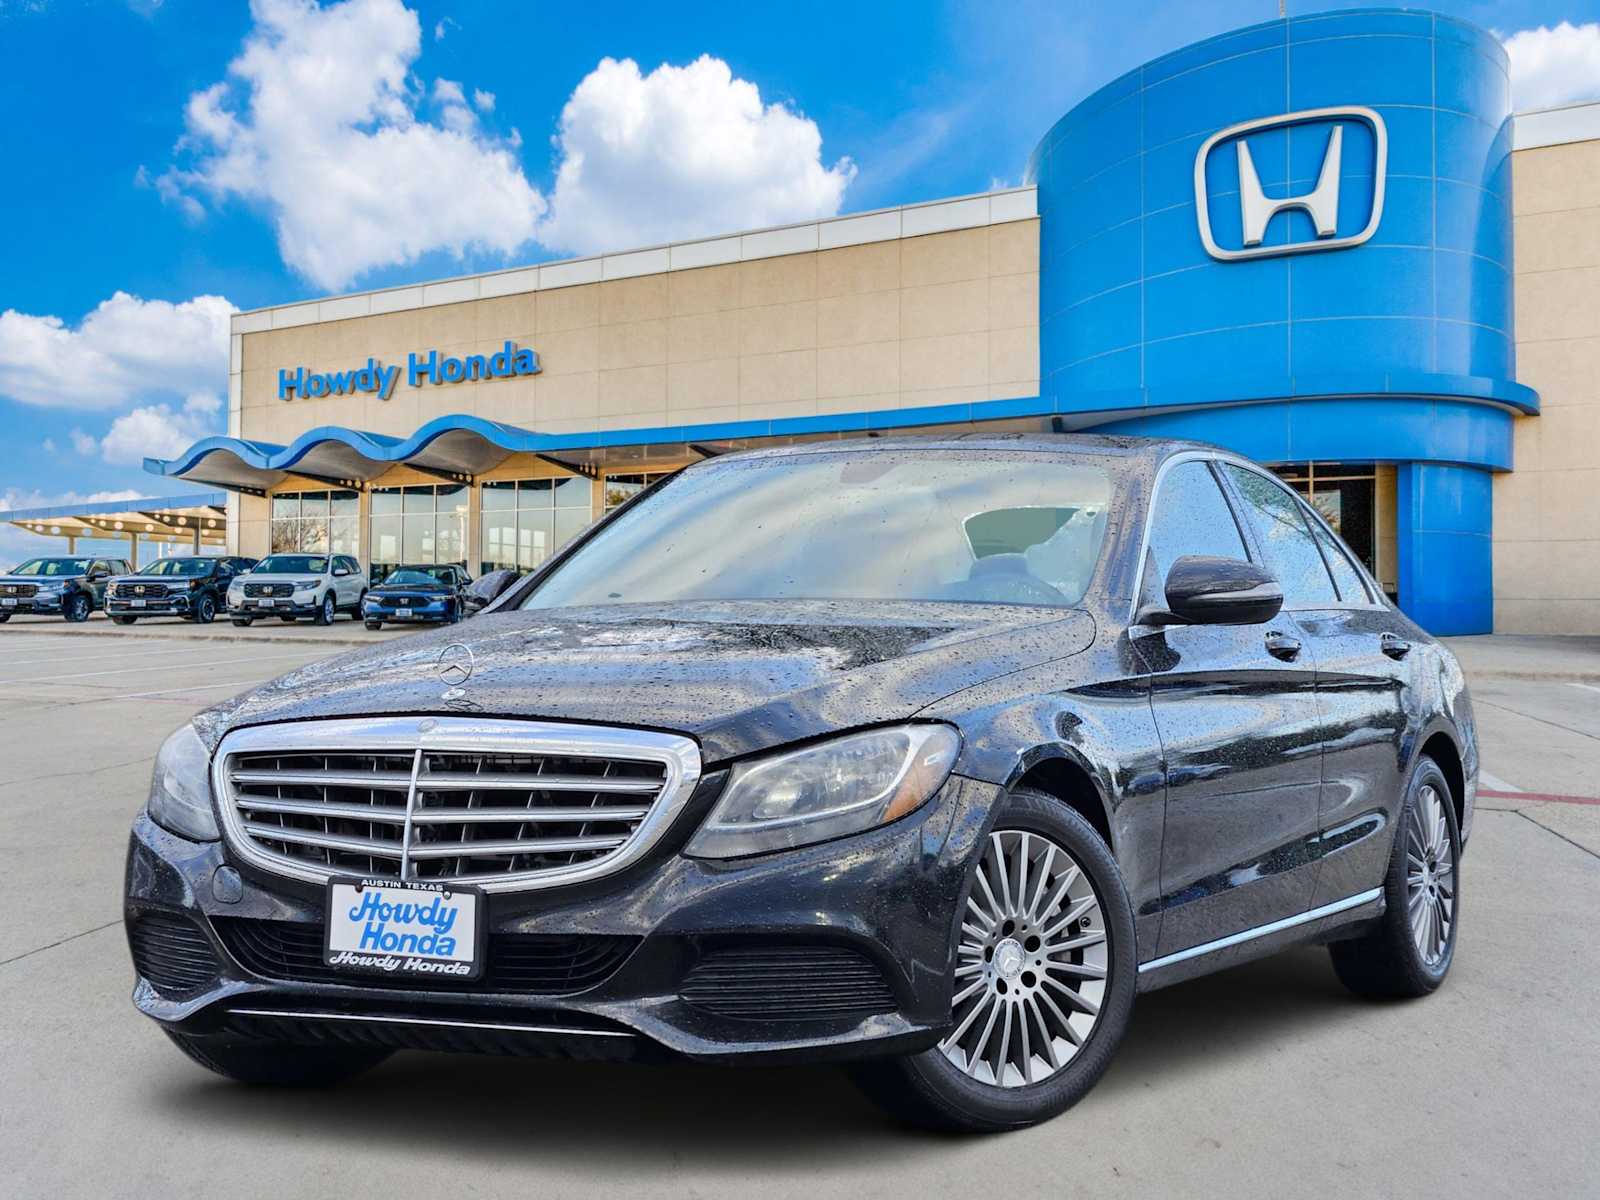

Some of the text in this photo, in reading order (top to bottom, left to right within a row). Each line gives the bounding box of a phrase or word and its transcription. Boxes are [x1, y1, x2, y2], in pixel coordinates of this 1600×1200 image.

[278, 341, 541, 401] Howdy Honda
[361, 879, 444, 891] AUSTIN TEXAS
[349, 891, 458, 935] Howdy
[359, 922, 457, 956] Honda
[329, 951, 471, 975] Howdy Honda
